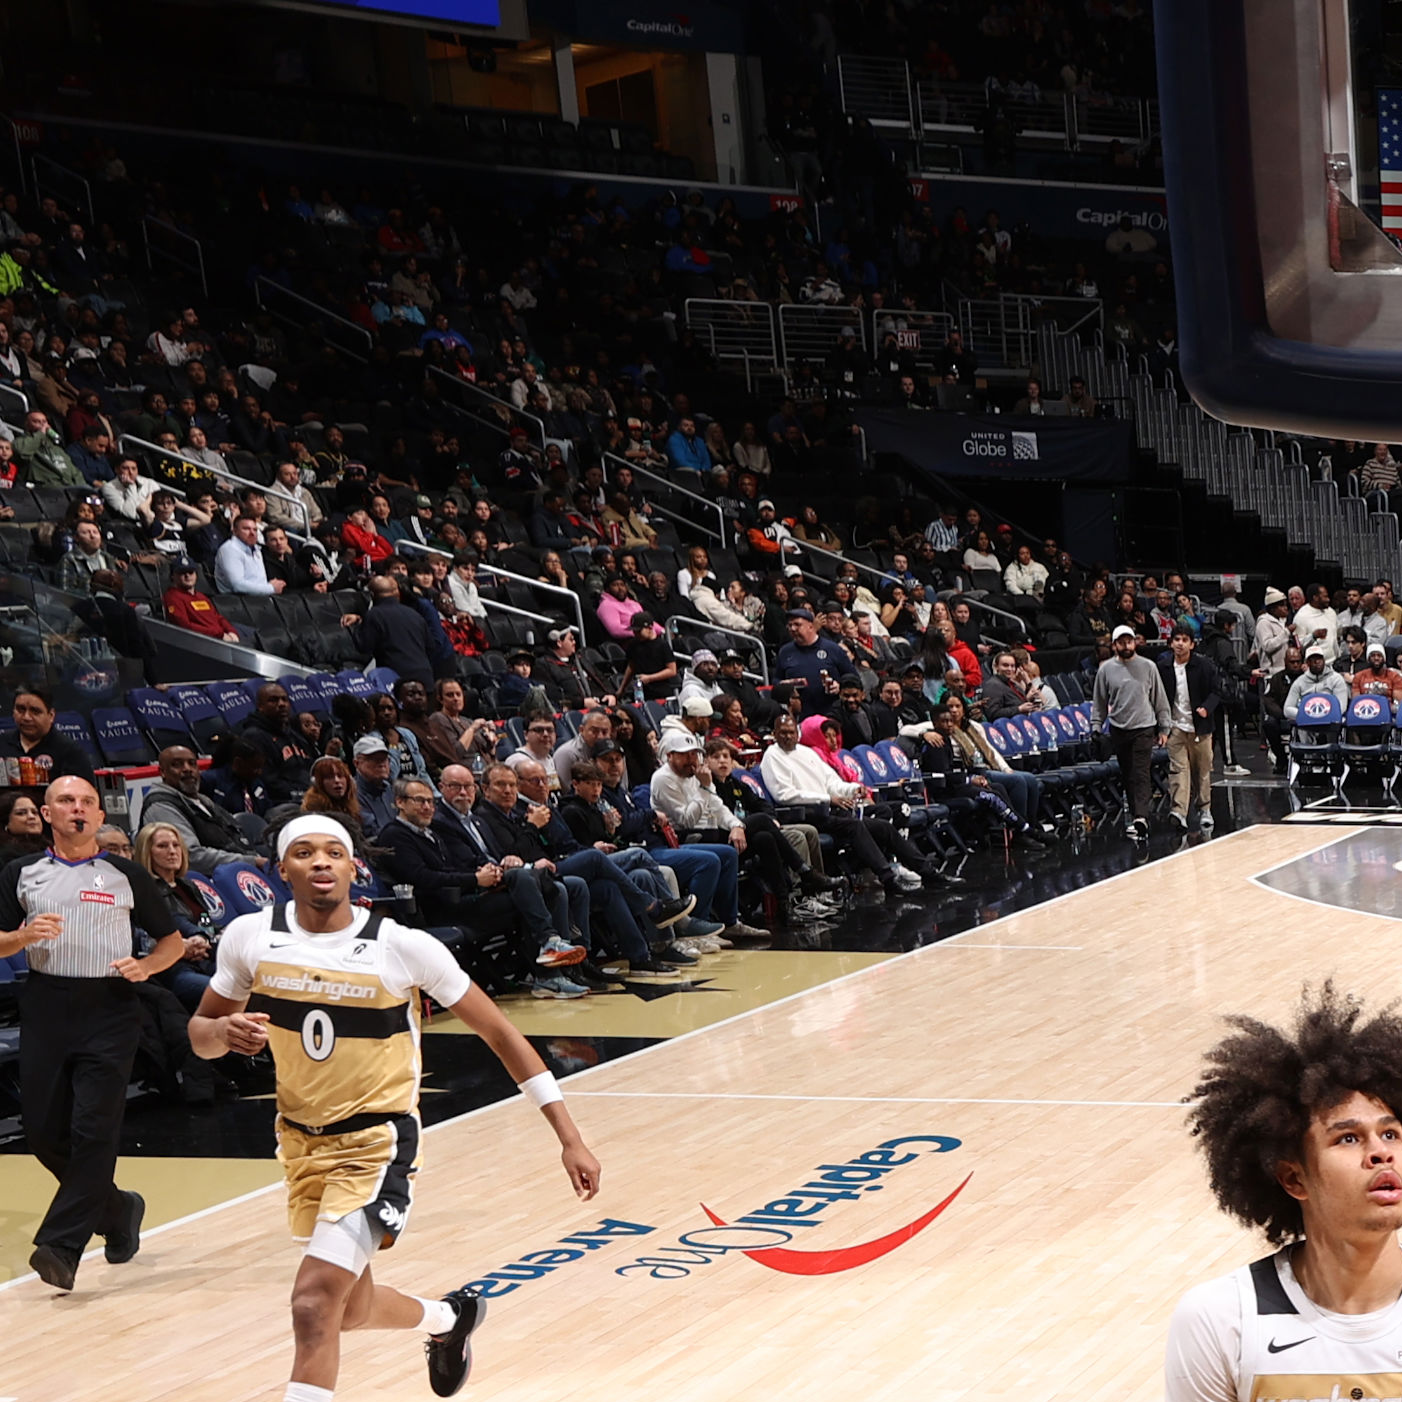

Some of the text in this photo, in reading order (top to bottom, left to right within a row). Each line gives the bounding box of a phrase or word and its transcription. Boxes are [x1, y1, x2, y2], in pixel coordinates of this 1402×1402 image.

[897, 331, 918, 348] EXIT
[970, 431, 1006, 440] UNITED
[962, 439, 1008, 457] Globe
[261, 973, 378, 1001] washington
[301, 1008, 336, 1063] 0
